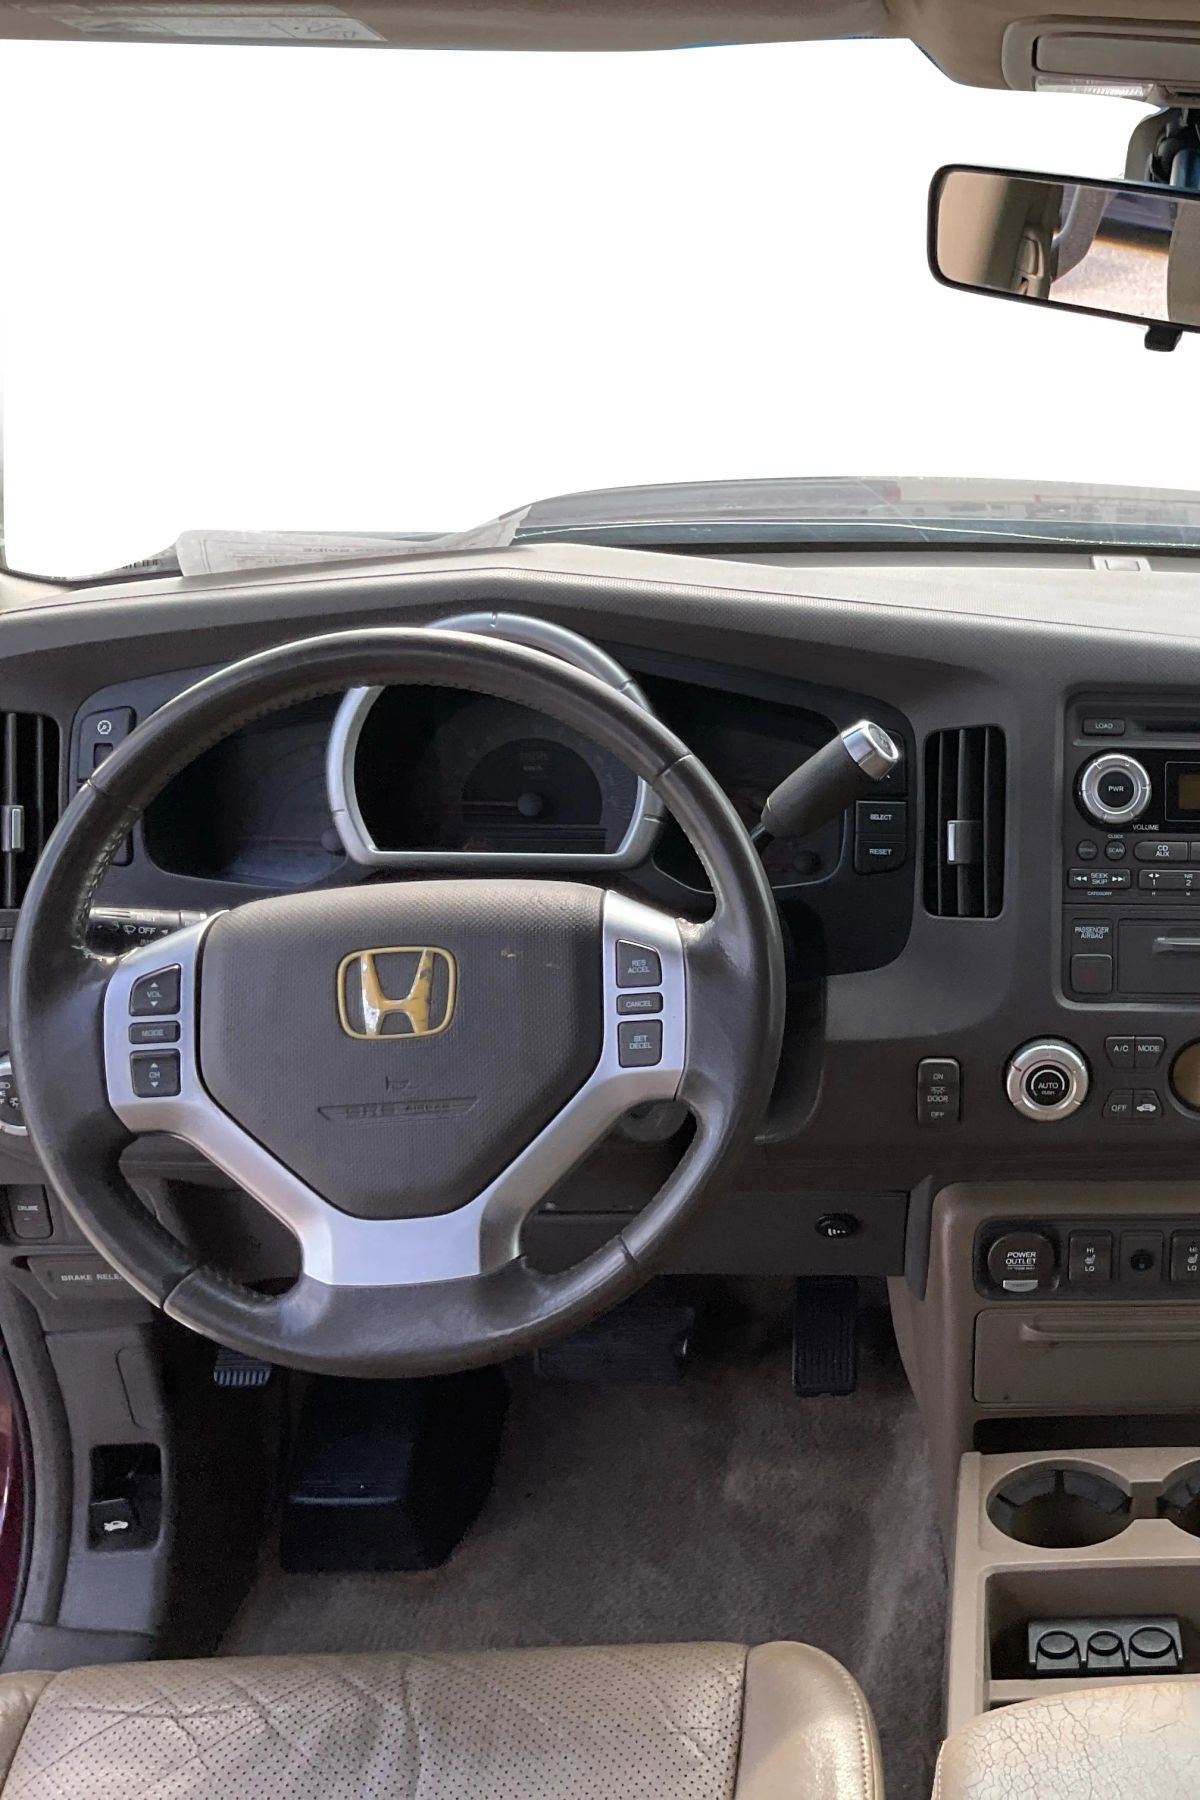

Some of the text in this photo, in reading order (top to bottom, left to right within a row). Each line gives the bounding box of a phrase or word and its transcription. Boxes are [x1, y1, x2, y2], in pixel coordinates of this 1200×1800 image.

[1095, 722, 1114, 730] LOAD
[869, 813, 892, 821] SELECT
[138, 926, 157, 935] OFF
[627, 966, 651, 974] ACCEL
[147, 990, 163, 998] VOL
[141, 1029, 164, 1037] MODE
[629, 1042, 653, 1050] DECEL
[927, 1095, 949, 1103] DOOR
[1111, 1104, 1129, 1112] OFF
